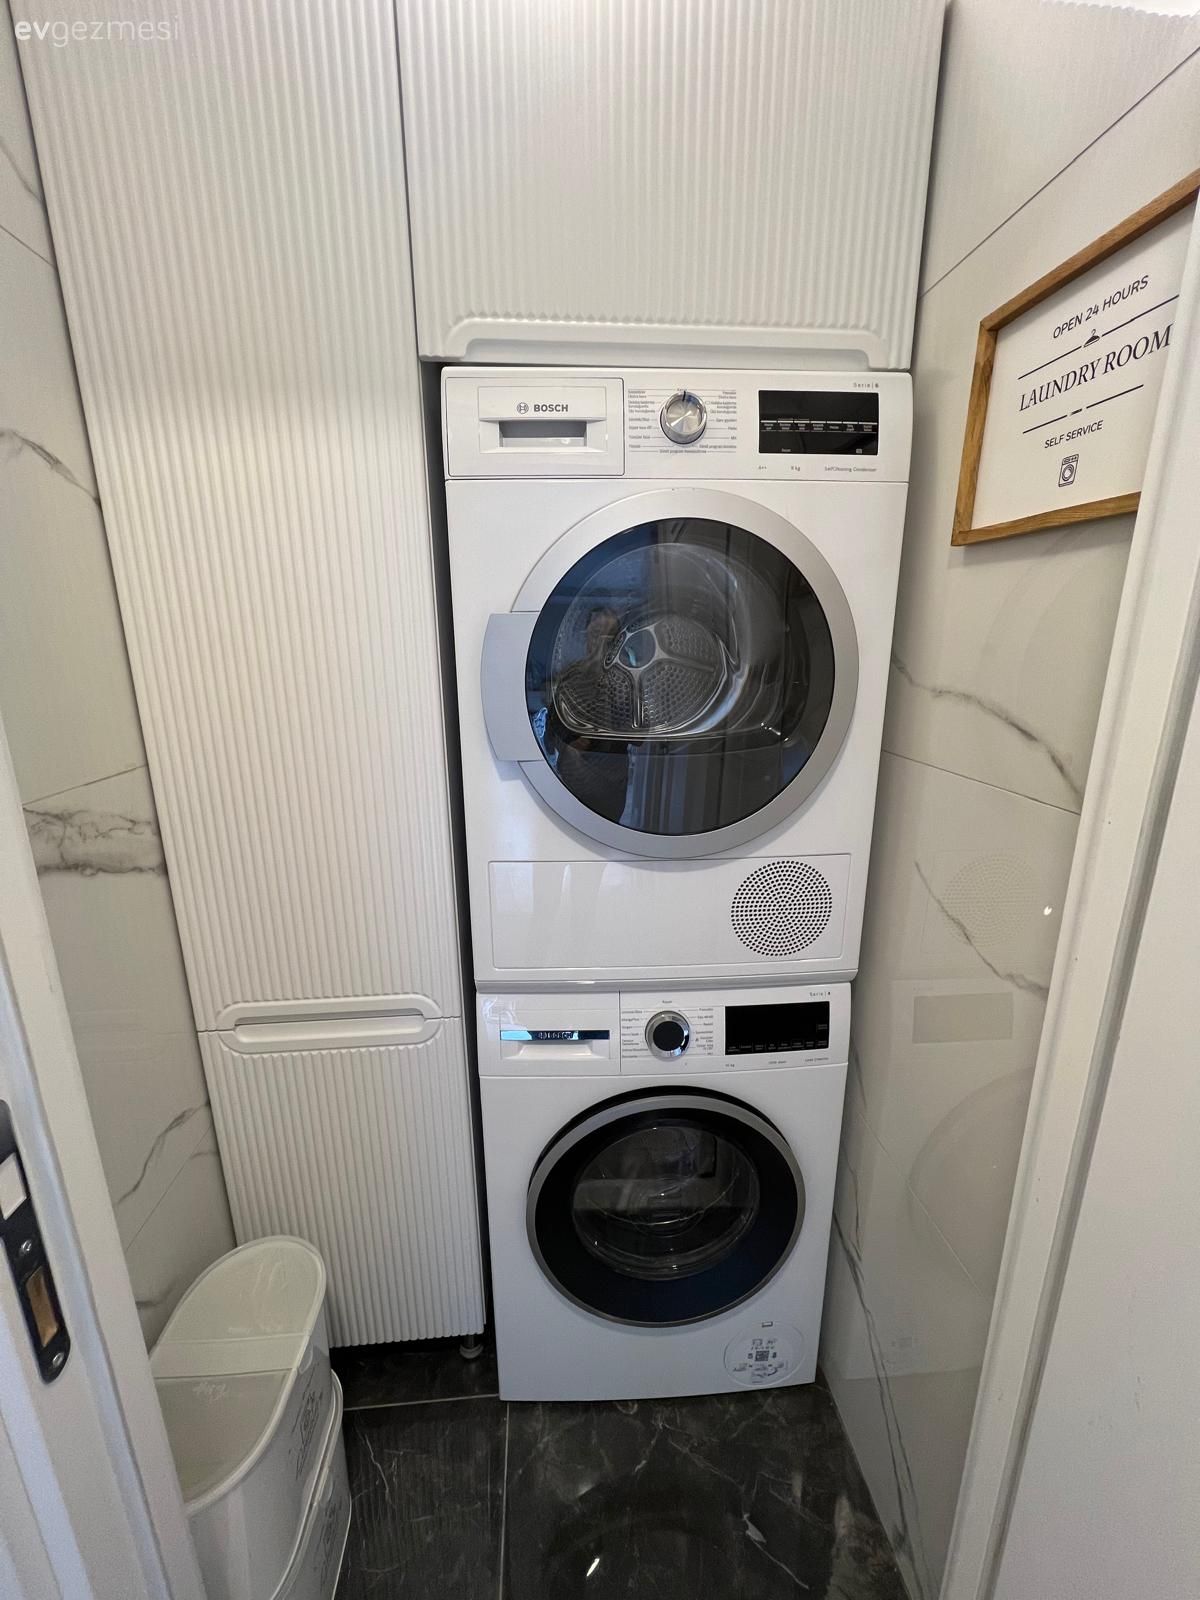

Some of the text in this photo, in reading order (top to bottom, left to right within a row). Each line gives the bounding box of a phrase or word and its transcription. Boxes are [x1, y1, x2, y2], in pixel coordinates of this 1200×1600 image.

[1053, 275, 1149, 339] OPEN 24 HOURS
[1019, 323, 1173, 412] LAUNDRY ROOM
[533, 403, 569, 413] BOSCH
[1044, 420, 1104, 449] SELF SERVICE
